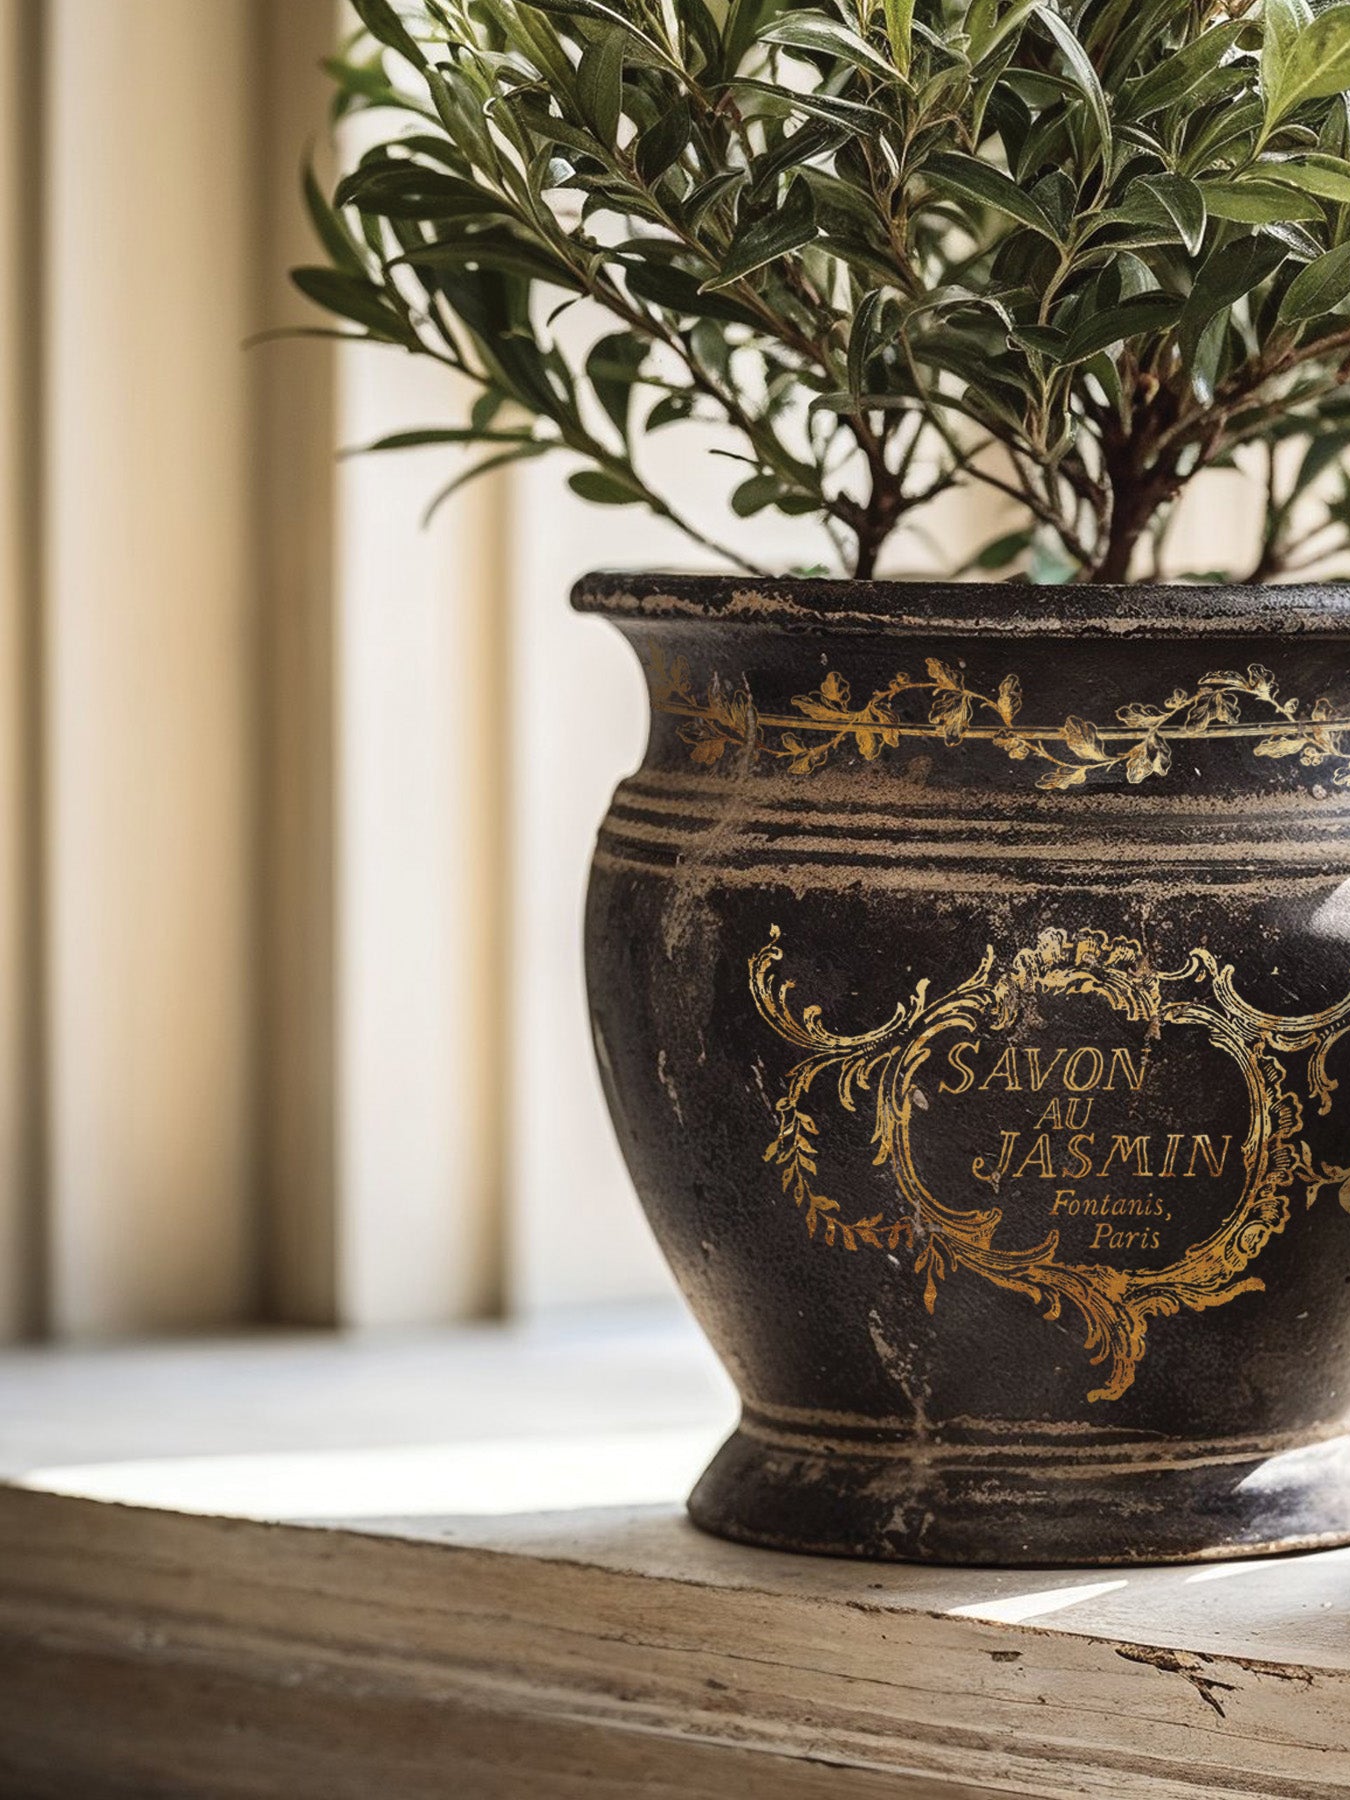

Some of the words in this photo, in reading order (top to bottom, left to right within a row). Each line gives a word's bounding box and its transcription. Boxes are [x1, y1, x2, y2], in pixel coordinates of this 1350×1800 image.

[939, 1041, 1152, 1094] SAVON
[1034, 1098, 1094, 1130] AU
[972, 1130, 1232, 1180] JASMIN
[1049, 1189, 1173, 1221] Fontanis,
[1089, 1223, 1161, 1250] Paris
